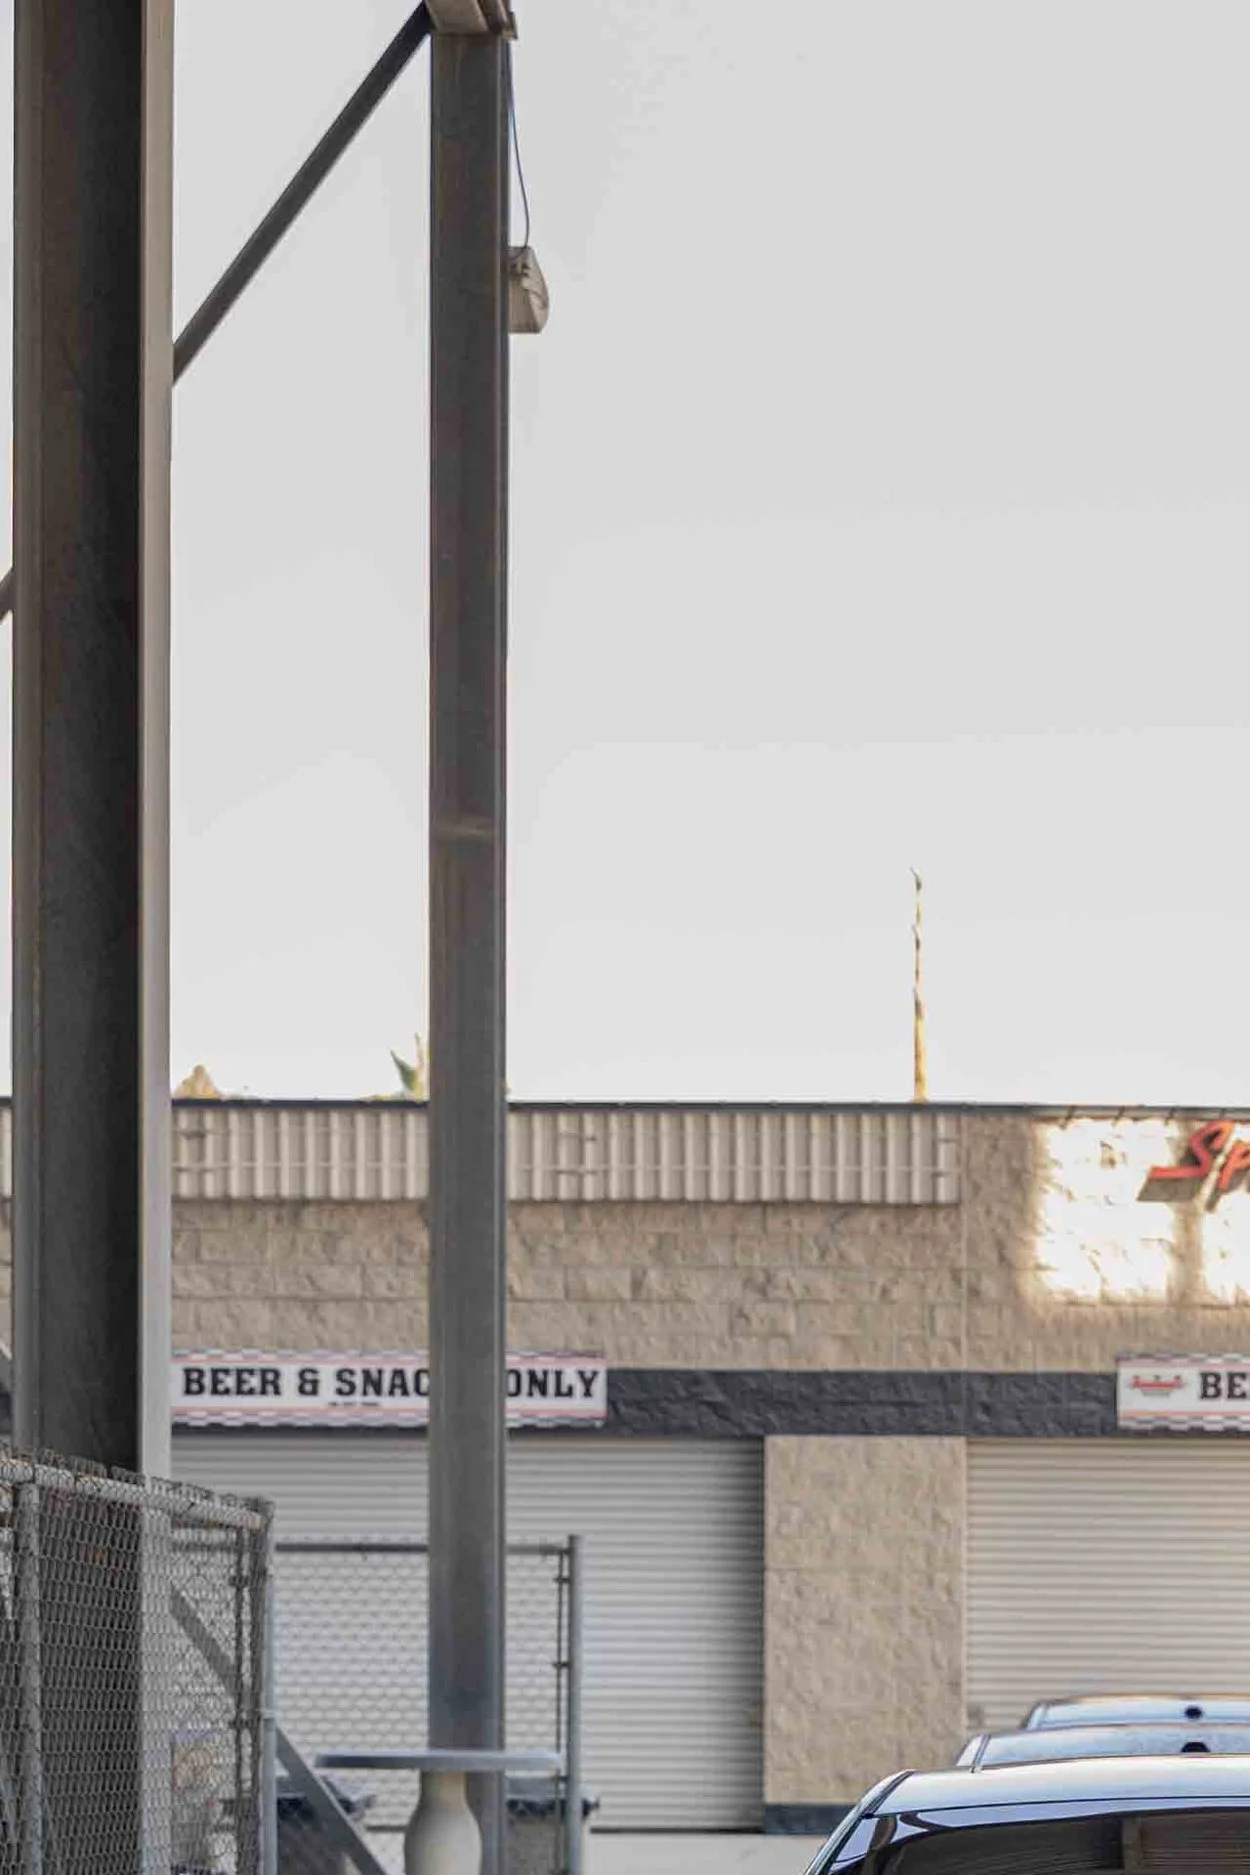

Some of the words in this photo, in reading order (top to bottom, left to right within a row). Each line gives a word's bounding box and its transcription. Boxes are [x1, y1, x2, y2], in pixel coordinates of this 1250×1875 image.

[183, 1366, 282, 1397] BEER
[297, 1367, 320, 1397] &
[335, 1367, 430, 1397] SNAC
